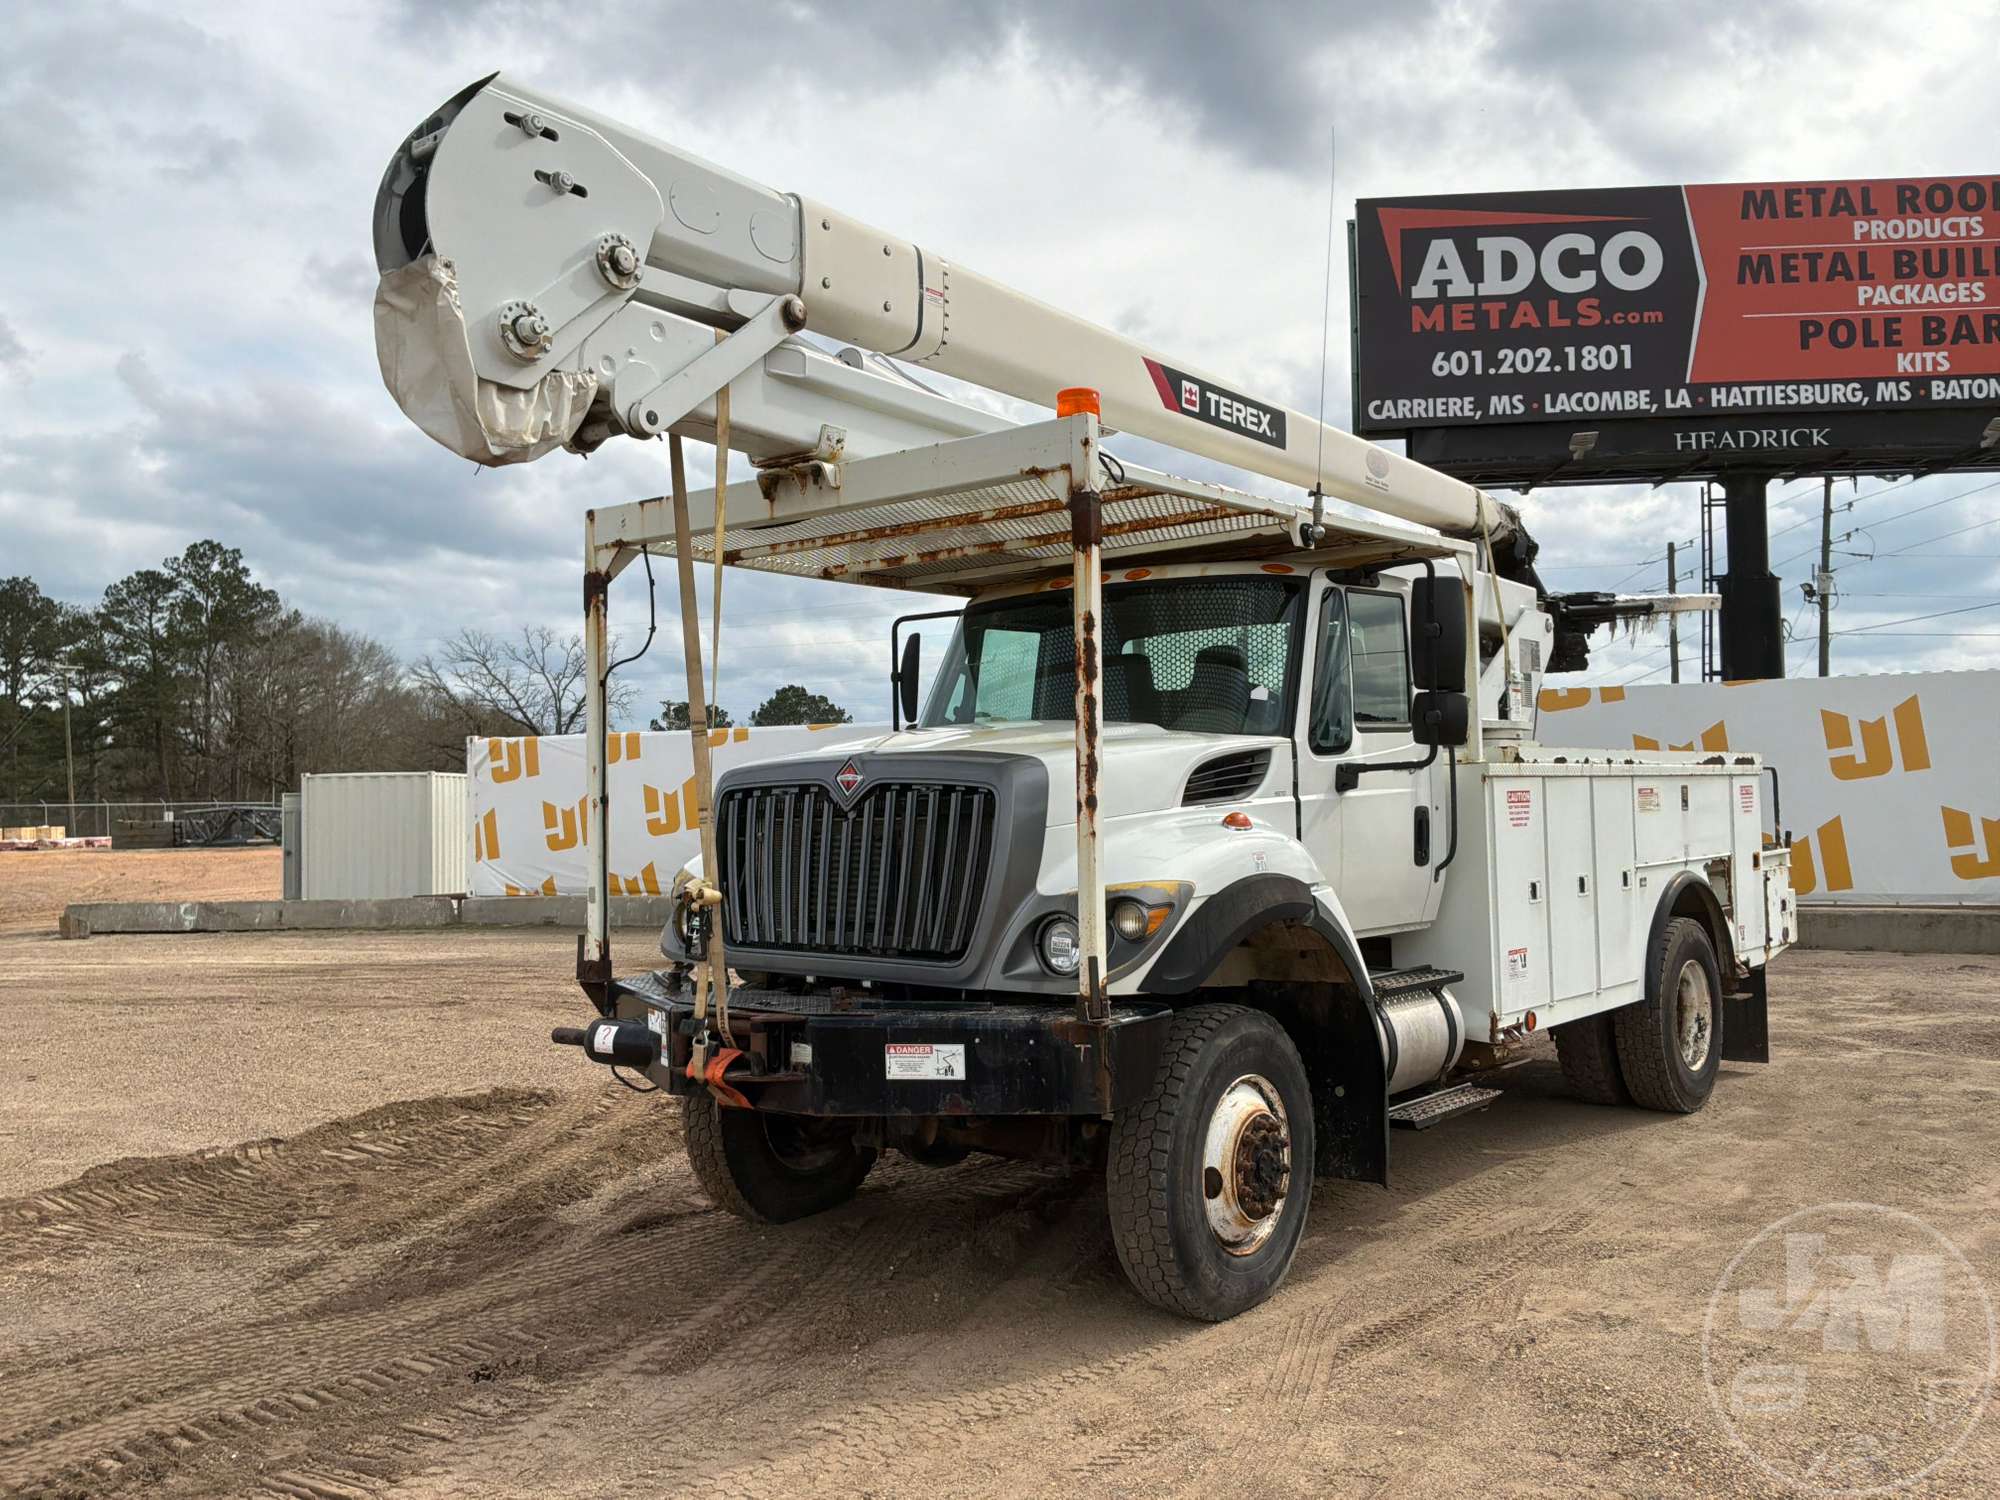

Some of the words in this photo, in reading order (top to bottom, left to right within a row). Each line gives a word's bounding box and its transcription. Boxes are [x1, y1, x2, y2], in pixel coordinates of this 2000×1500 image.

[1740, 186, 1878, 220] METAL
[1853, 216, 1984, 240] PRODUCTS
[1411, 230, 1664, 298] ADCO
[1737, 251, 1875, 285] METAL
[1893, 246, 2000, 280] BUIL
[1857, 282, 1986, 306] PACKAGES
[1799, 317, 1903, 351] POLE
[1431, 344, 1632, 377] 601.202.1801
[1897, 351, 1951, 373] KITS
[1205, 391, 1273, 437] TEREX
[1367, 396, 1482, 420] CARRIERE,
[1489, 394, 1525, 415] MS
[1544, 390, 1658, 413] LACOMBE,
[1665, 388, 1692, 409] LA
[1711, 382, 1869, 407] HATTIESBURG,
[1876, 381, 1912, 402] MS
[1674, 427, 1832, 450] HEADRICK
[896, 1046, 931, 1054] DANGER
